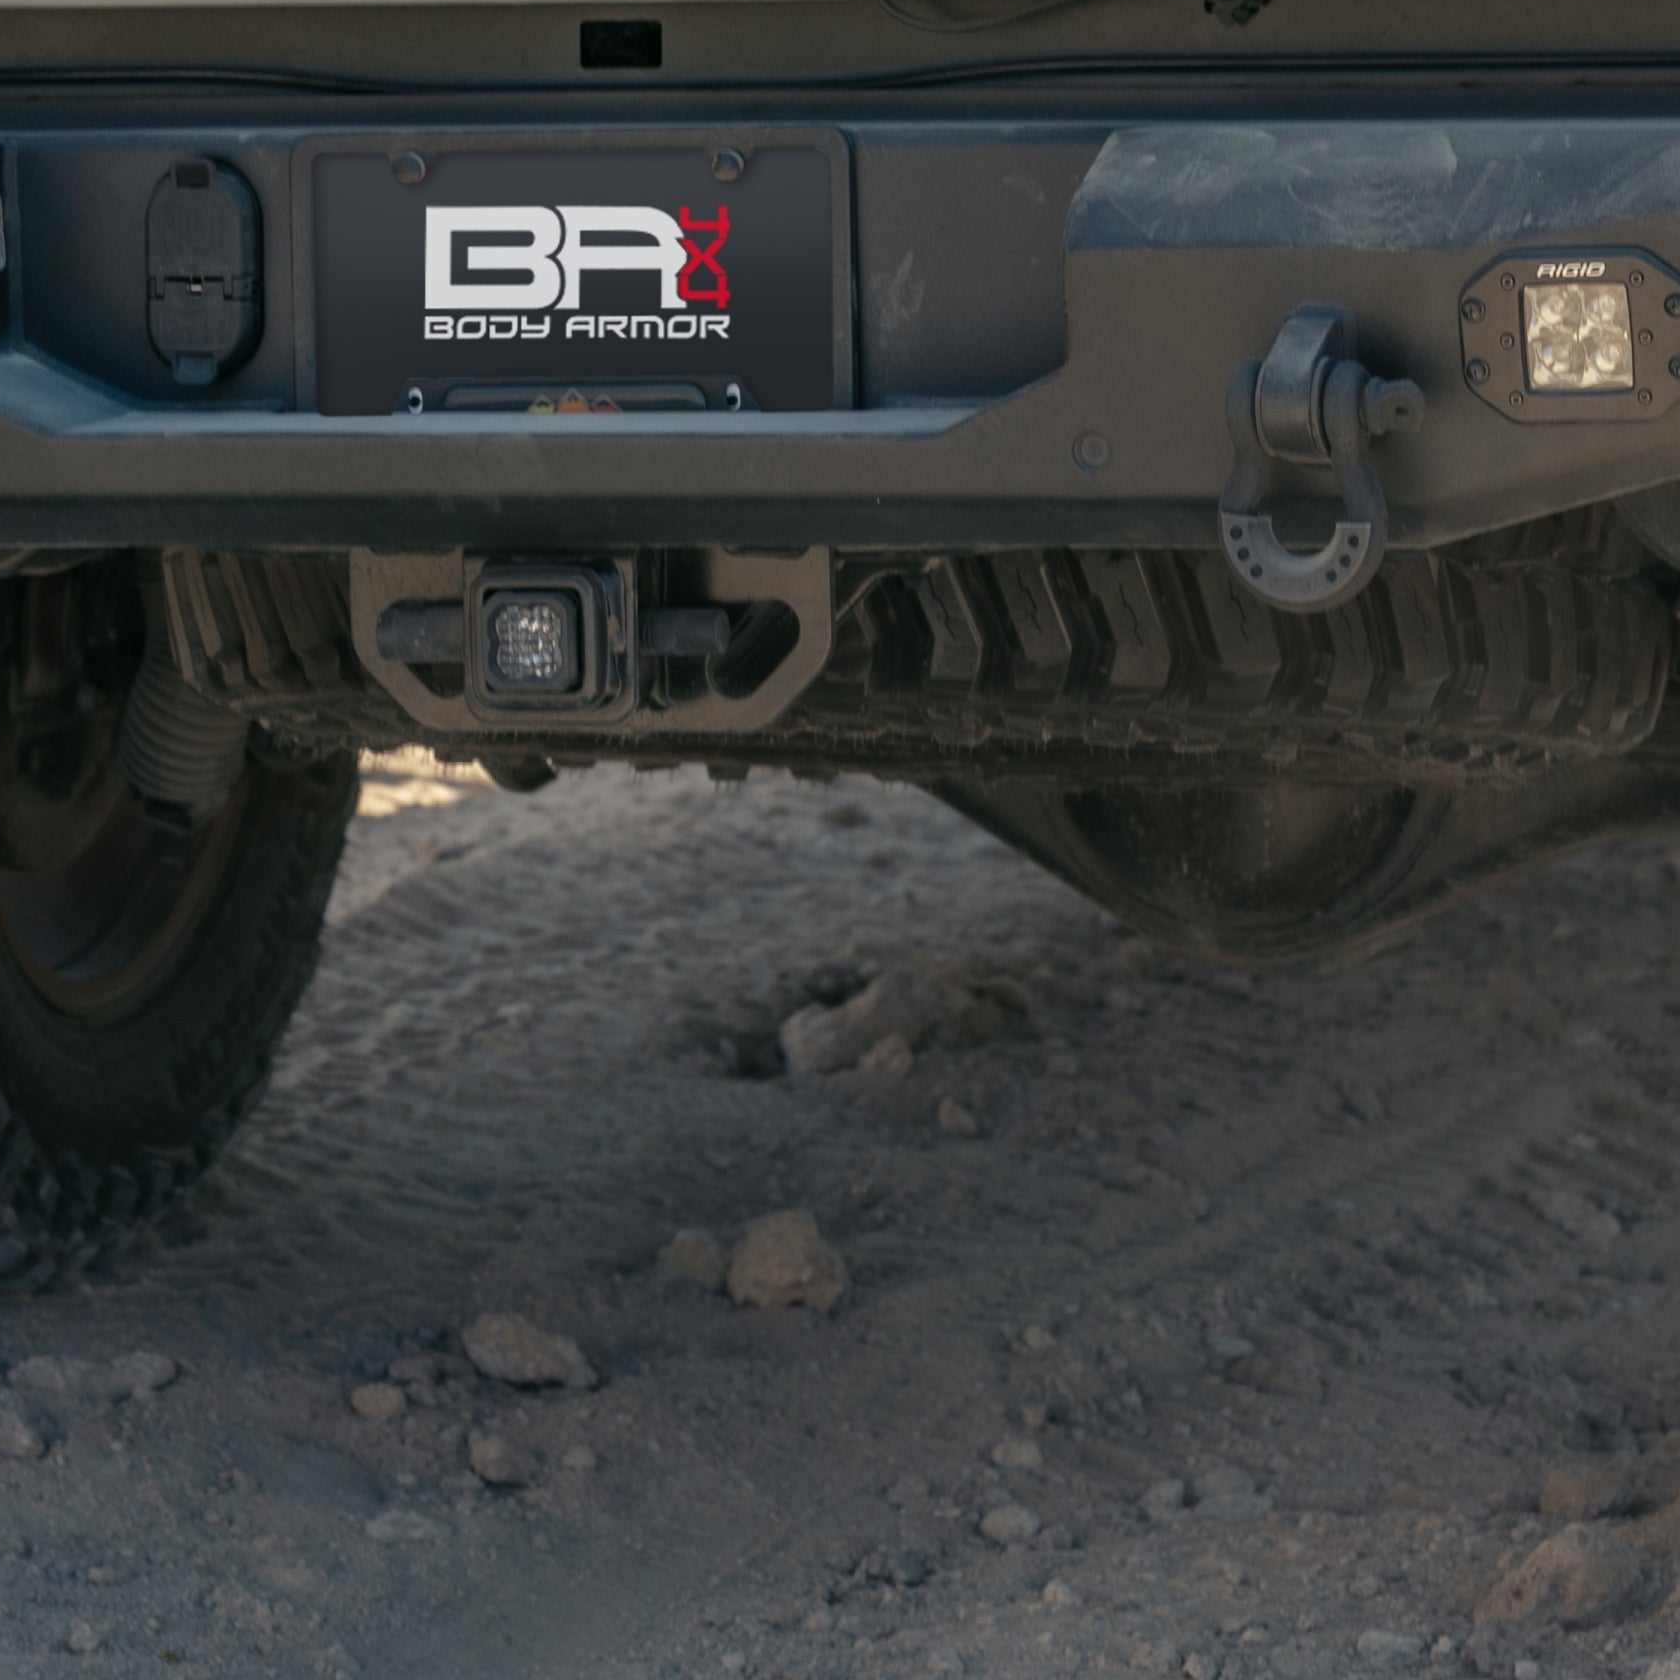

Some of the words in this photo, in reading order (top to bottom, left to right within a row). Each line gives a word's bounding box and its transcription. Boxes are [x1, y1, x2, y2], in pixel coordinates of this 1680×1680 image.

[425, 205, 688, 310] BA
[1536, 261, 1606, 279] RIGID
[424, 315, 551, 340] BODY
[565, 315, 731, 340] ARMOR
